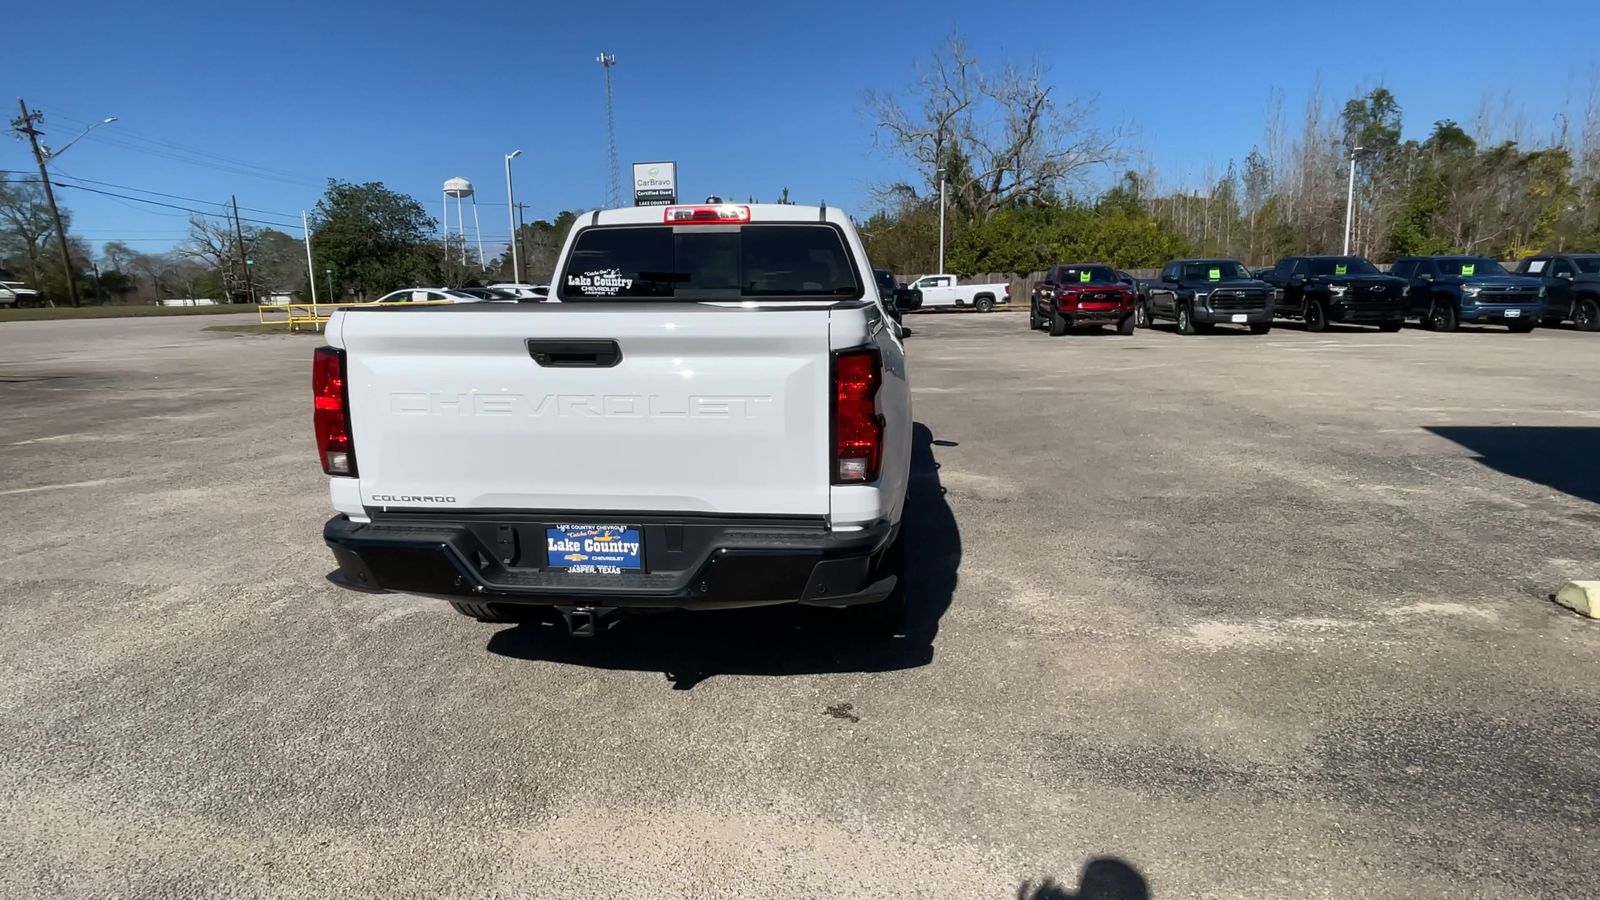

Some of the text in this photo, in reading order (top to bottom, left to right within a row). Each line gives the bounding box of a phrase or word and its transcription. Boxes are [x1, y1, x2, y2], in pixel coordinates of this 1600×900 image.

[637, 178, 670, 186] CarBravo
[568, 275, 632, 289] Lake Country
[390, 392, 772, 418] CHEVROLET
[548, 538, 639, 556] Lake Country
